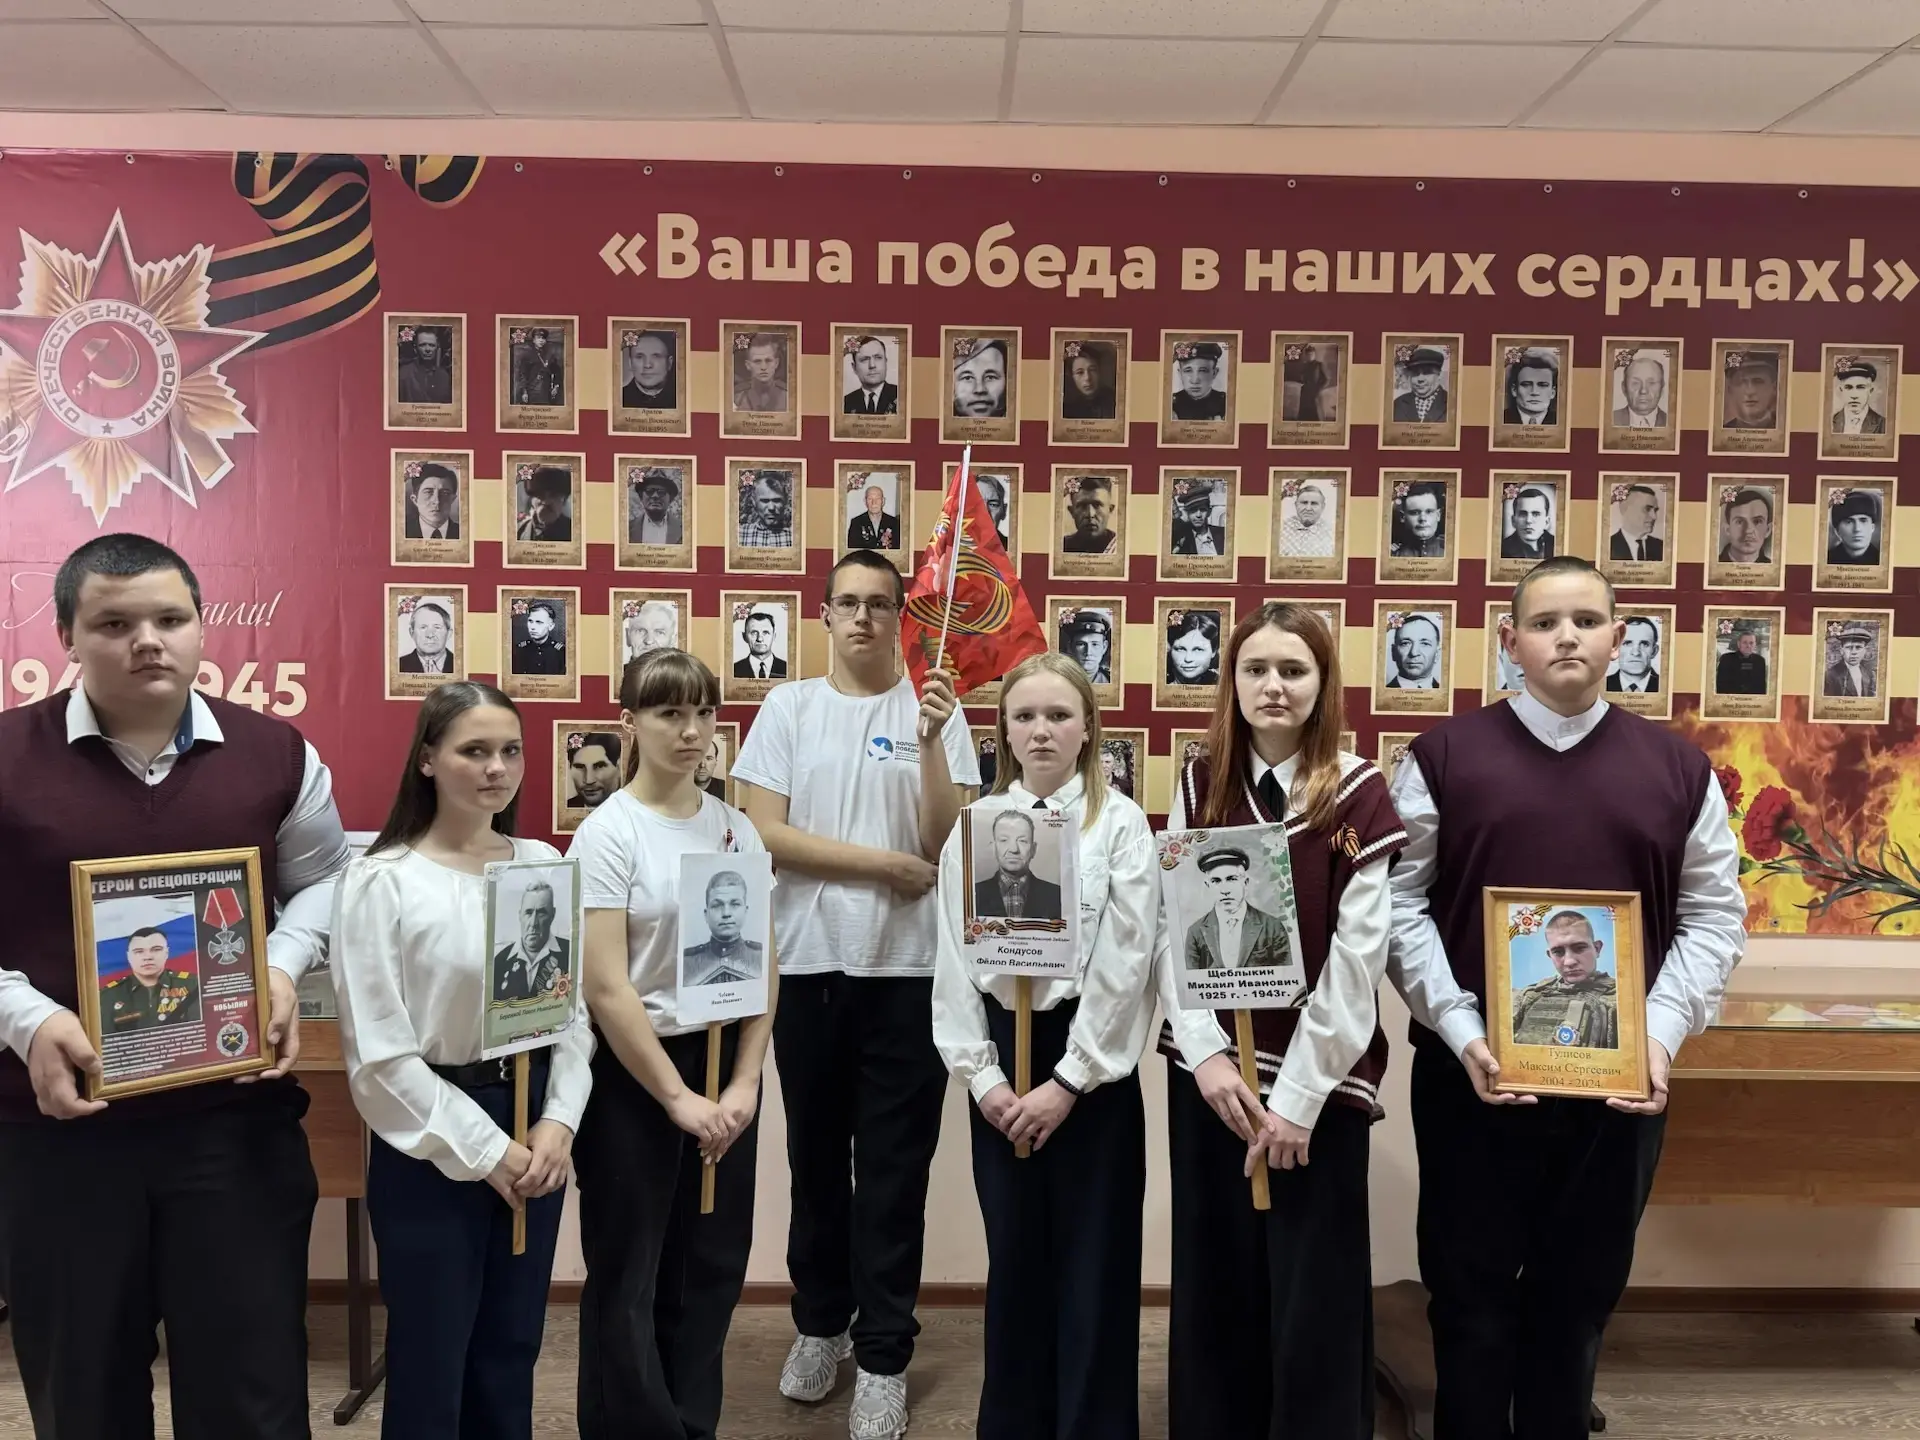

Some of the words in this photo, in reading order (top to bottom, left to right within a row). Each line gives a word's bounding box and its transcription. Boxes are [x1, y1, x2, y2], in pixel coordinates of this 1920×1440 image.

[599, 212, 853, 285] «Ваша
[877, 221, 1157, 298] победа
[1181, 247, 1221, 291] в
[1244, 247, 1496, 295] наших
[1516, 238, 1920, 316] сердцах!»
[43, 304, 168, 424] ОТЕЧЕСТВЕННАЯ
[138, 868, 242, 890] СПЕЦОПЕРАЦИИ
[997, 944, 1043, 956] Кондусов
[1207, 968, 1275, 979] Щеблыкин
[1187, 980, 1235, 990] Михаил
[1238, 978, 1300, 988] Иванович
[1198, 991, 1227, 1000] 1925
[1251, 989, 1291, 998] 1943г.
[1519, 1060, 1562, 1073] Максим
[1564, 1062, 1621, 1076] Сергеевич
[1539, 1076, 1565, 1087] 2004
